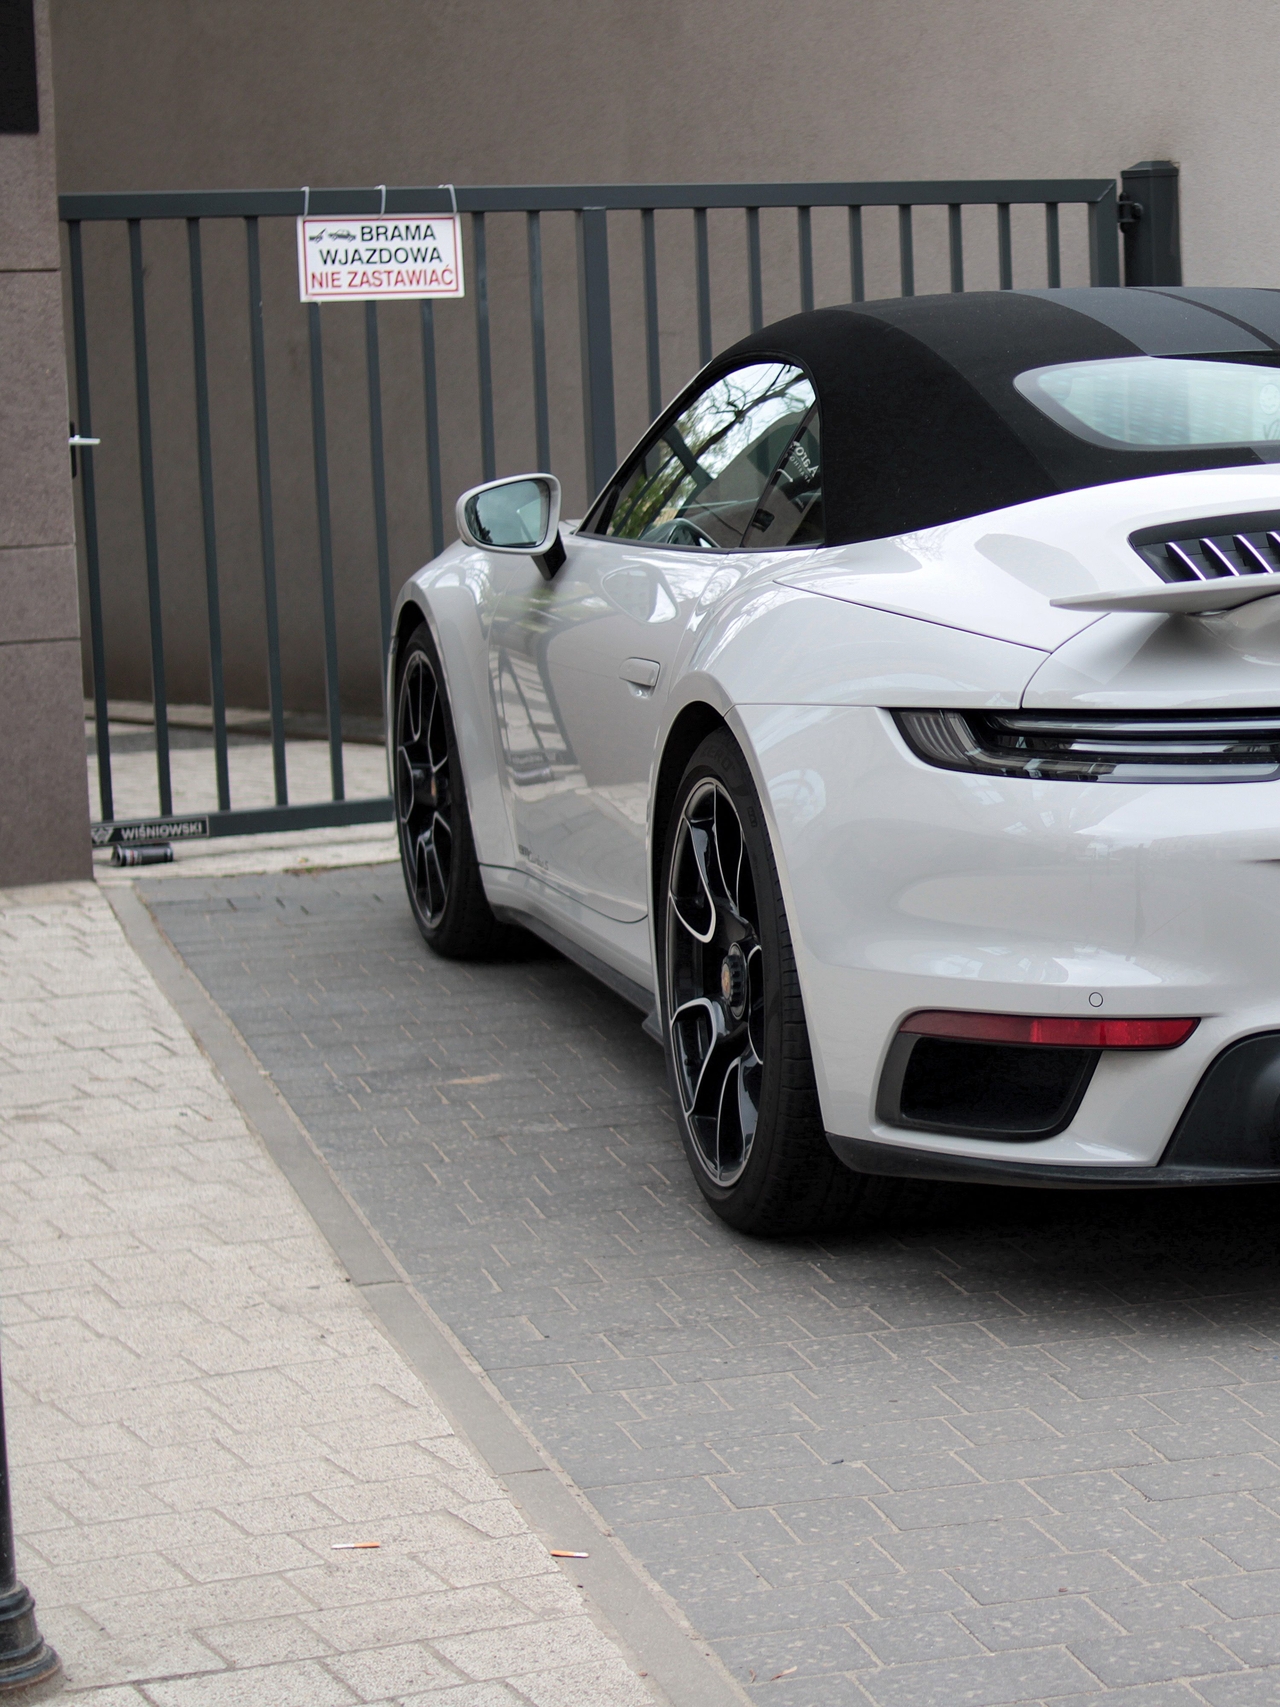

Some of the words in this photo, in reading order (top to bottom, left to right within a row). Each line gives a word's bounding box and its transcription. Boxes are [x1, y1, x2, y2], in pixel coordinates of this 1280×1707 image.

[360, 224, 437, 242] BRAMA
[319, 246, 443, 266] WJAZDOWA
[311, 271, 342, 290] NIE
[347, 264, 454, 288] ZASTAWIAĆ
[121, 822, 203, 841] WIŚNIOWSKI
